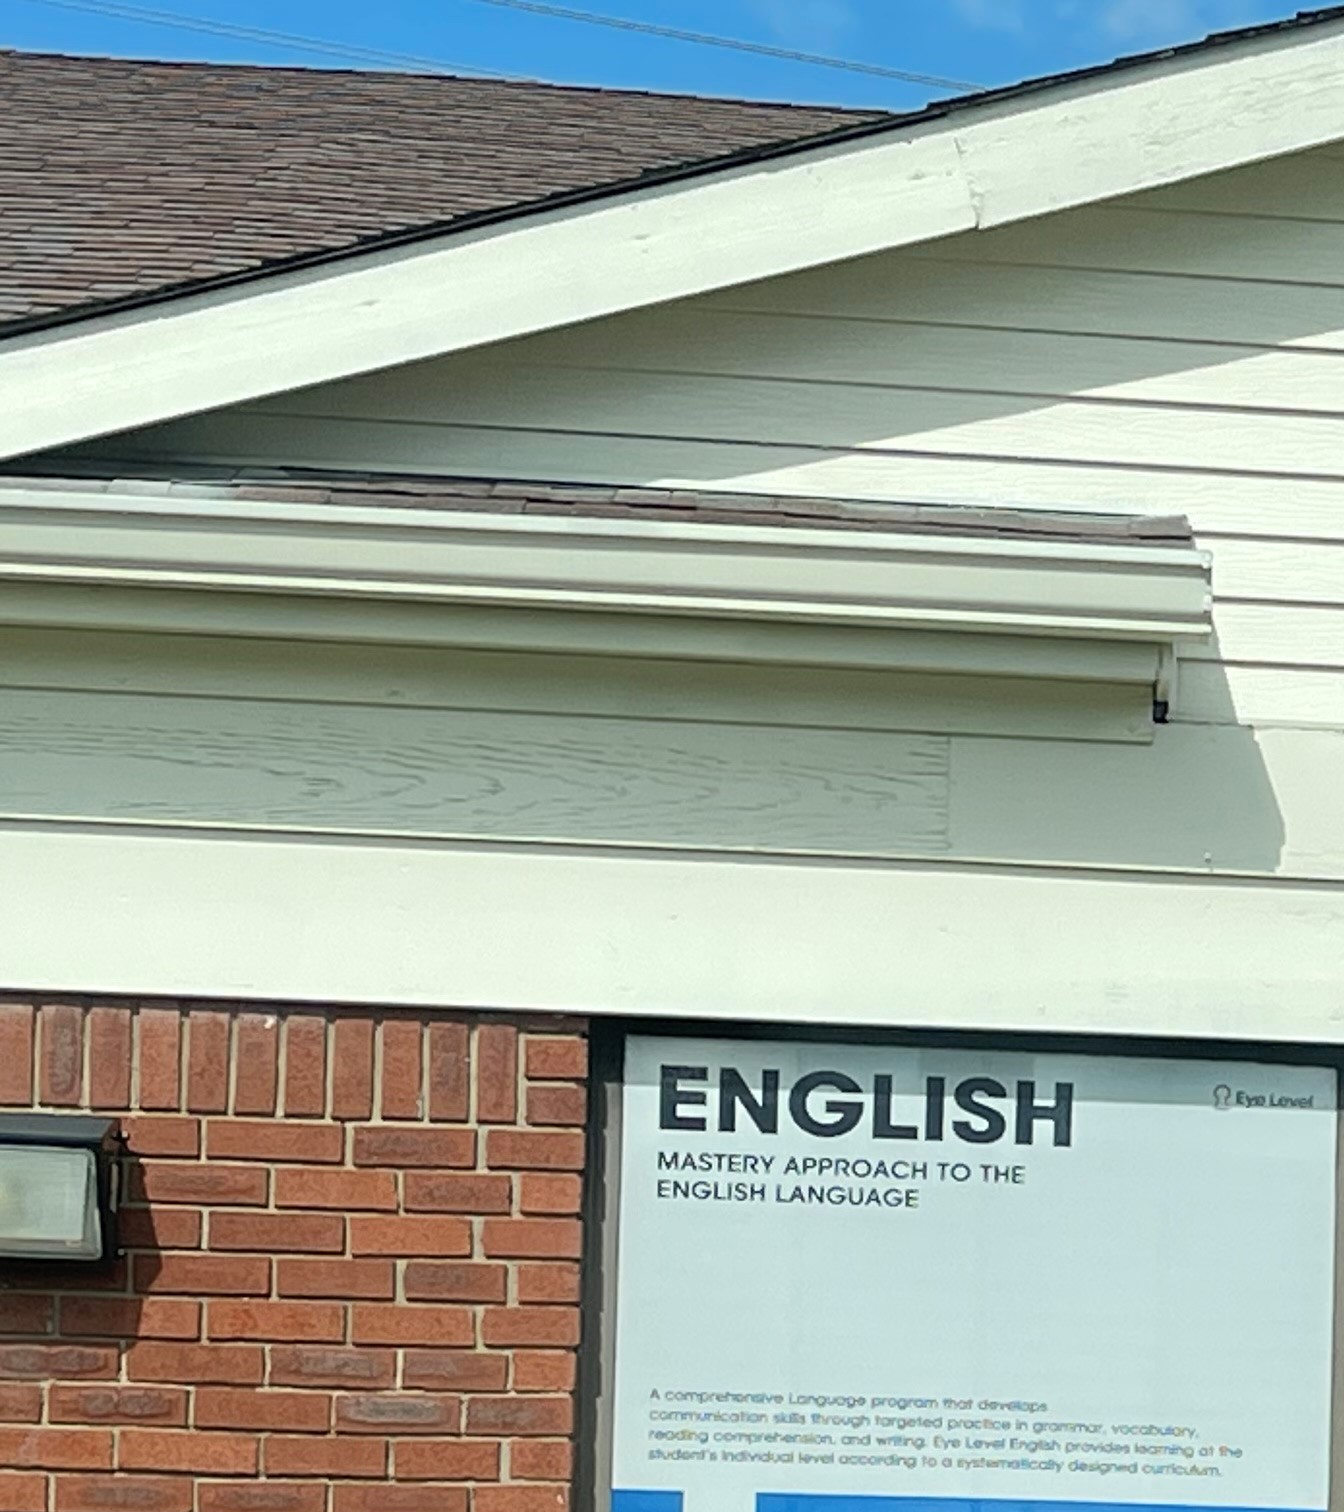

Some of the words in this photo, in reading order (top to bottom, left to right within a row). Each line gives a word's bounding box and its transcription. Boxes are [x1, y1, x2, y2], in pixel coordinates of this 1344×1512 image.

[658, 1064, 1074, 1148] ENGLISH
[657, 1152, 773, 1175] MASTERY
[784, 1156, 927, 1181] APPROACH
[938, 1161, 971, 1183] TO
[980, 1163, 1026, 1185] THE
[657, 1181, 766, 1204] ENGLISH
[775, 1184, 920, 1208] LANGUAGE
[650, 1388, 660, 1400] A
[665, 1389, 784, 1406] comprehensive
[789, 1393, 866, 1408] Language
[871, 1397, 938, 1410] program
[943, 1398, 973, 1410] that
[978, 1399, 1048, 1413] develops
[650, 1410, 767, 1423] communication
[773, 1413, 806, 1424] skills
[811, 1413, 870, 1428] through
[875, 1415, 942, 1429] targeted
[948, 1418, 1011, 1431] practice
[1015, 1419, 1028, 1431] in
[1111, 1424, 1200, 1439] vocabulary,
[649, 1429, 708, 1443] reading
[841, 1434, 871, 1446] and
[933, 1437, 960, 1452] Eye
[965, 1438, 1005, 1449] Level
[1010, 1438, 1059, 1454] English
[1065, 1442, 1130, 1455] provides
[1135, 1443, 1194, 1458] learning
[1199, 1446, 1214, 1457] at
[1219, 1446, 1243, 1458] the
[798, 1452, 835, 1464] level
[839, 1453, 917, 1469] according
[922, 1456, 937, 1468] to
[942, 1458, 952, 1469] a
[957, 1457, 1065, 1473] systematically
[1068, 1460, 1137, 1475] designed
[1142, 1463, 1222, 1477] curriculum.
